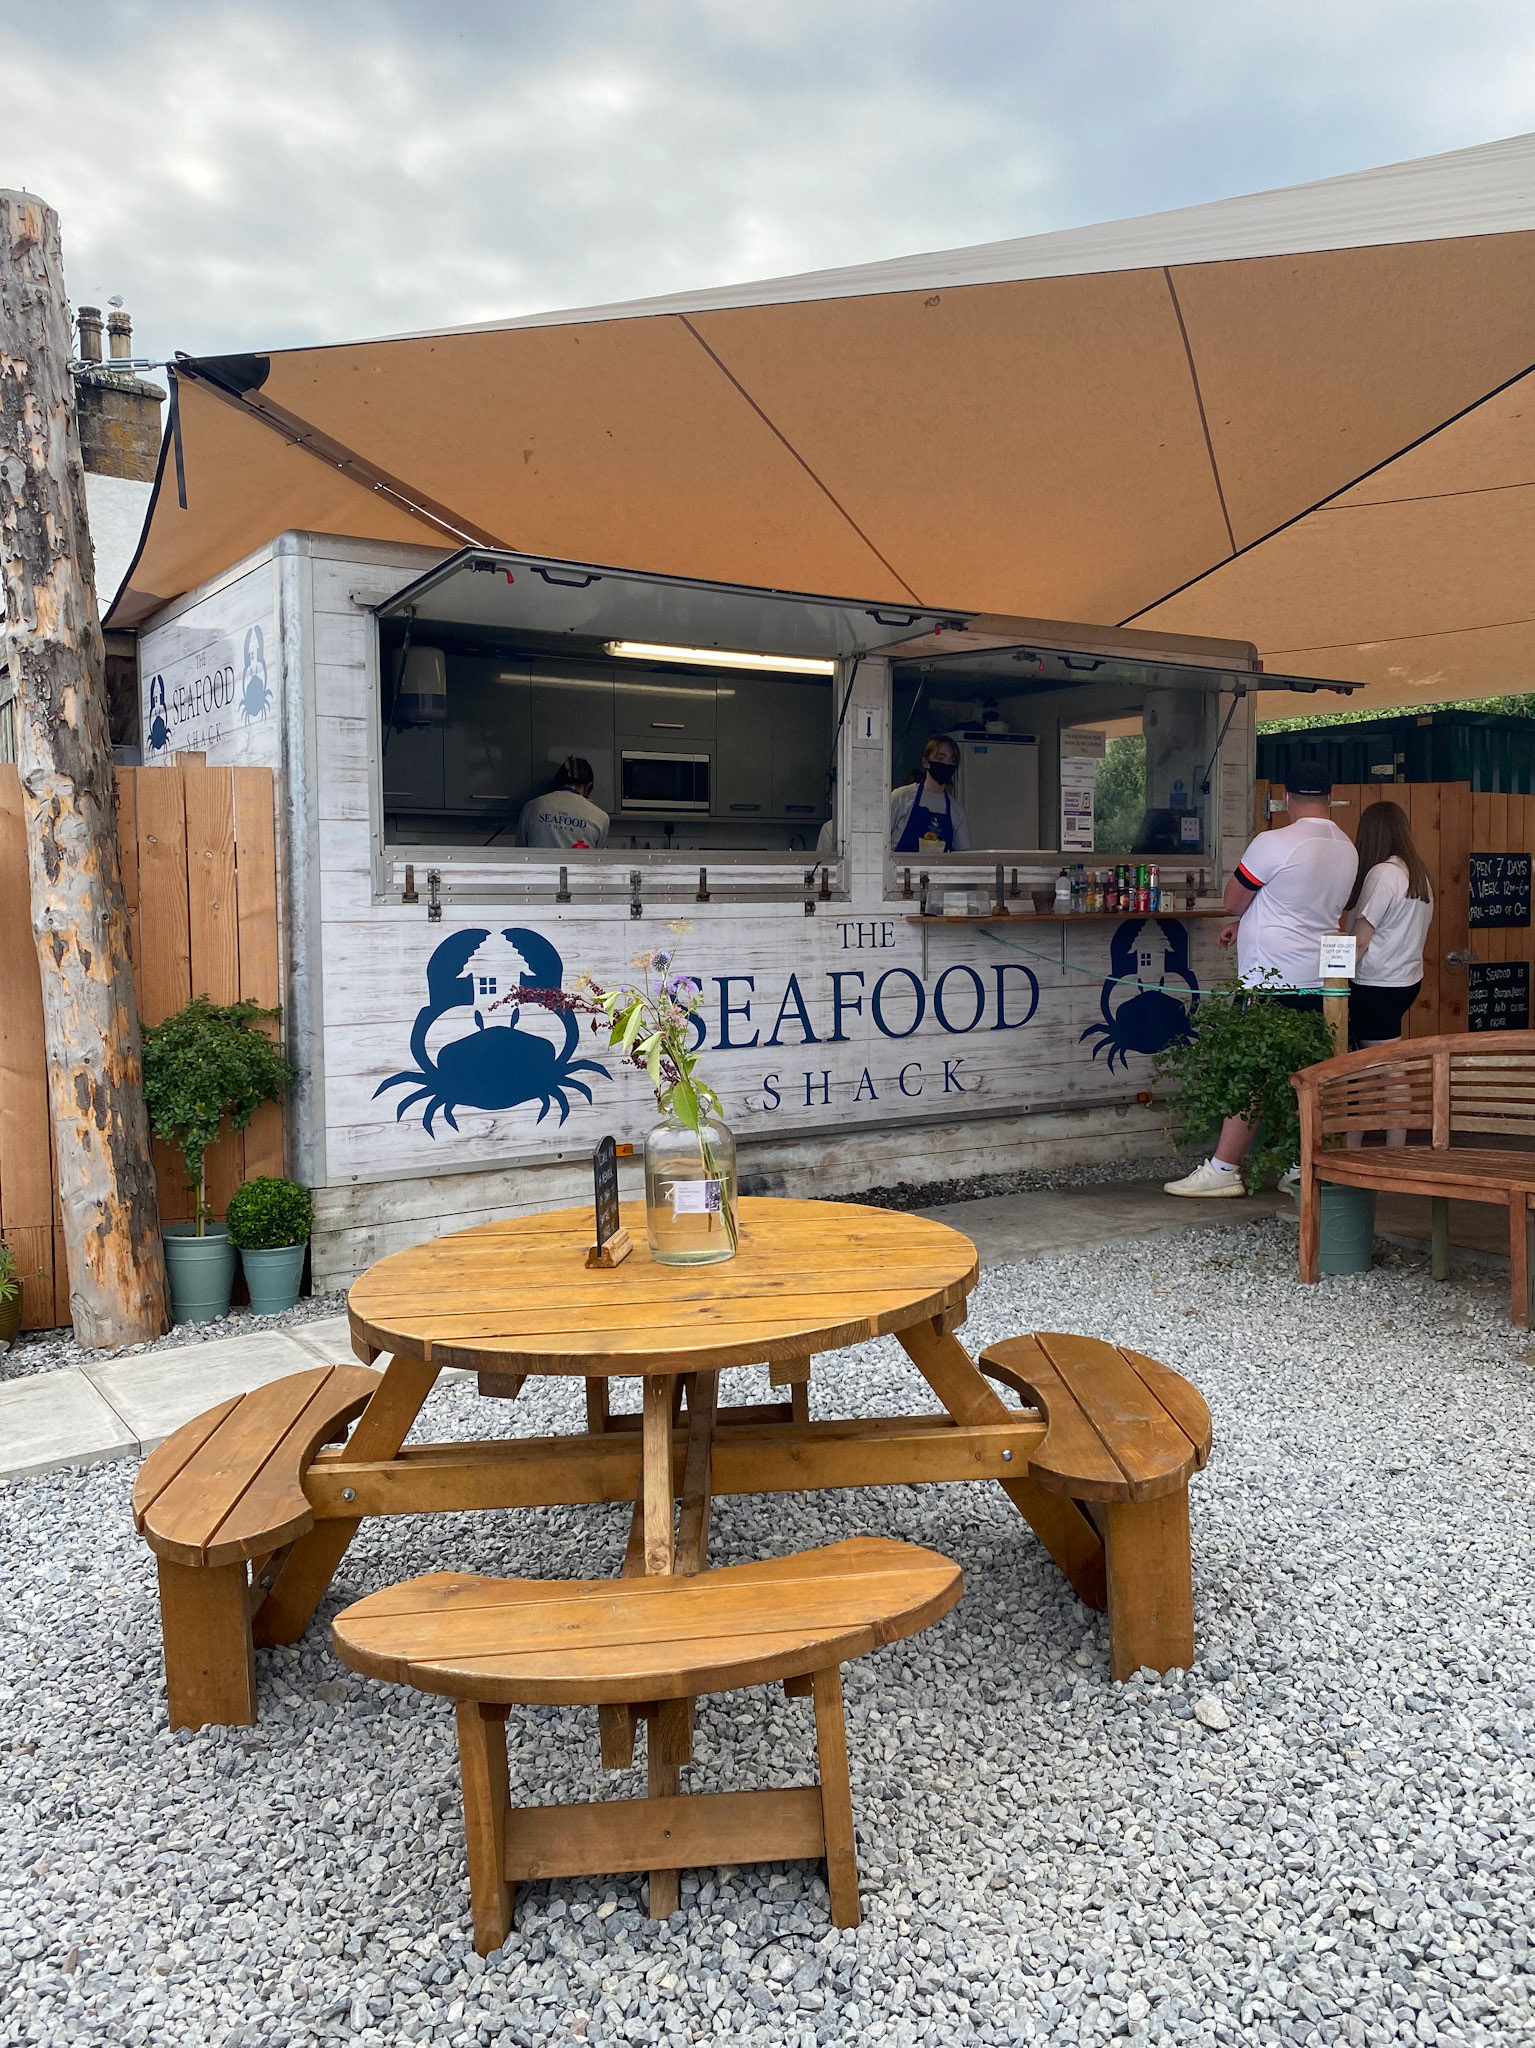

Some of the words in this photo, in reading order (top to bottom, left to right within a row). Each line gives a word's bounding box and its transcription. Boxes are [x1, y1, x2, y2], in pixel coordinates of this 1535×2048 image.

[196, 651, 207, 669] THE
[173, 666, 235, 725] SEAFOOD
[187, 722, 222, 750] SHACK
[538, 813, 587, 828] SEAFOOD
[549, 824, 574, 832] SHACK
[1496, 857, 1504, 878] 7
[1506, 860, 1528, 876] DAYS
[1477, 879, 1500, 898] WEEK
[836, 921, 896, 949] THE
[669, 964, 1040, 1050] SEAFOOD
[762, 1059, 965, 1111] SHACK
